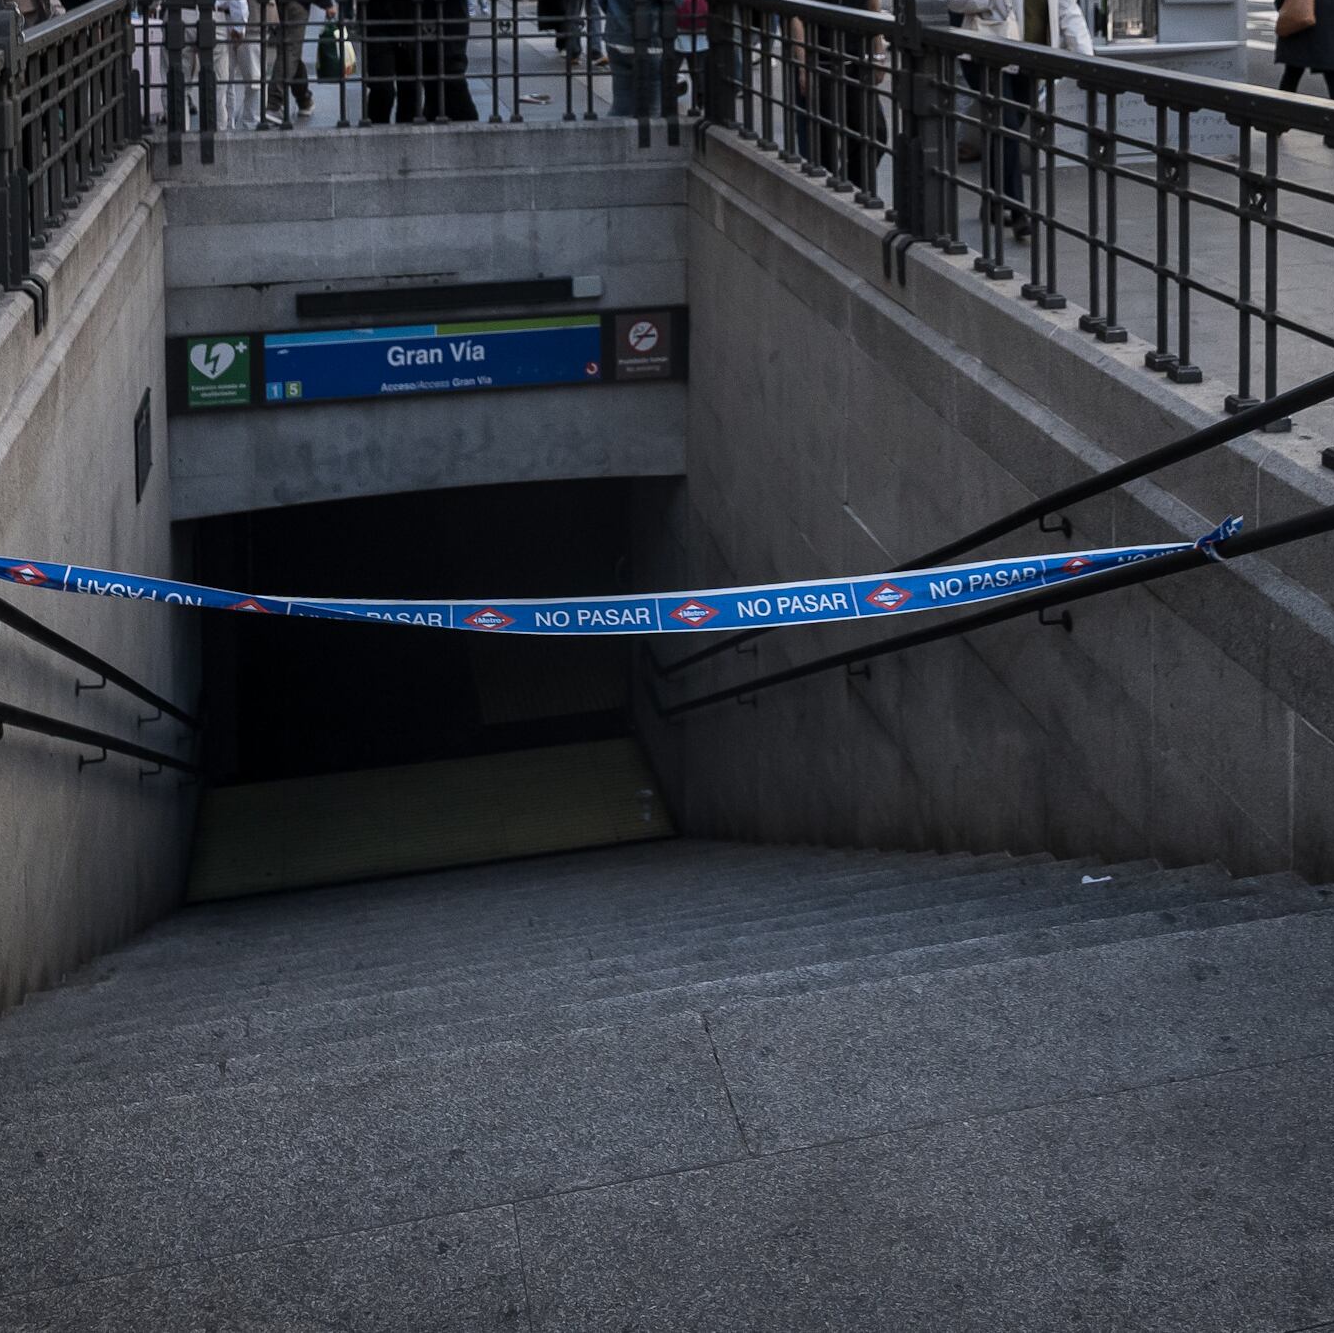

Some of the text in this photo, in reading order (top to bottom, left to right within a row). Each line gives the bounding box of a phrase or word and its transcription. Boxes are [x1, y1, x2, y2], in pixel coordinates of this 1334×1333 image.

[386, 340, 486, 367] Gran Vía
[271, 383, 298, 396] 1 5
[452, 377, 476, 387] Gran
[477, 375, 493, 385] Vía
[929, 577, 962, 600] NO
[969, 567, 1036, 593] PASAR
[683, 593, 849, 618] Metro NO PASAR
[477, 607, 651, 627] Metro NO PASAR
